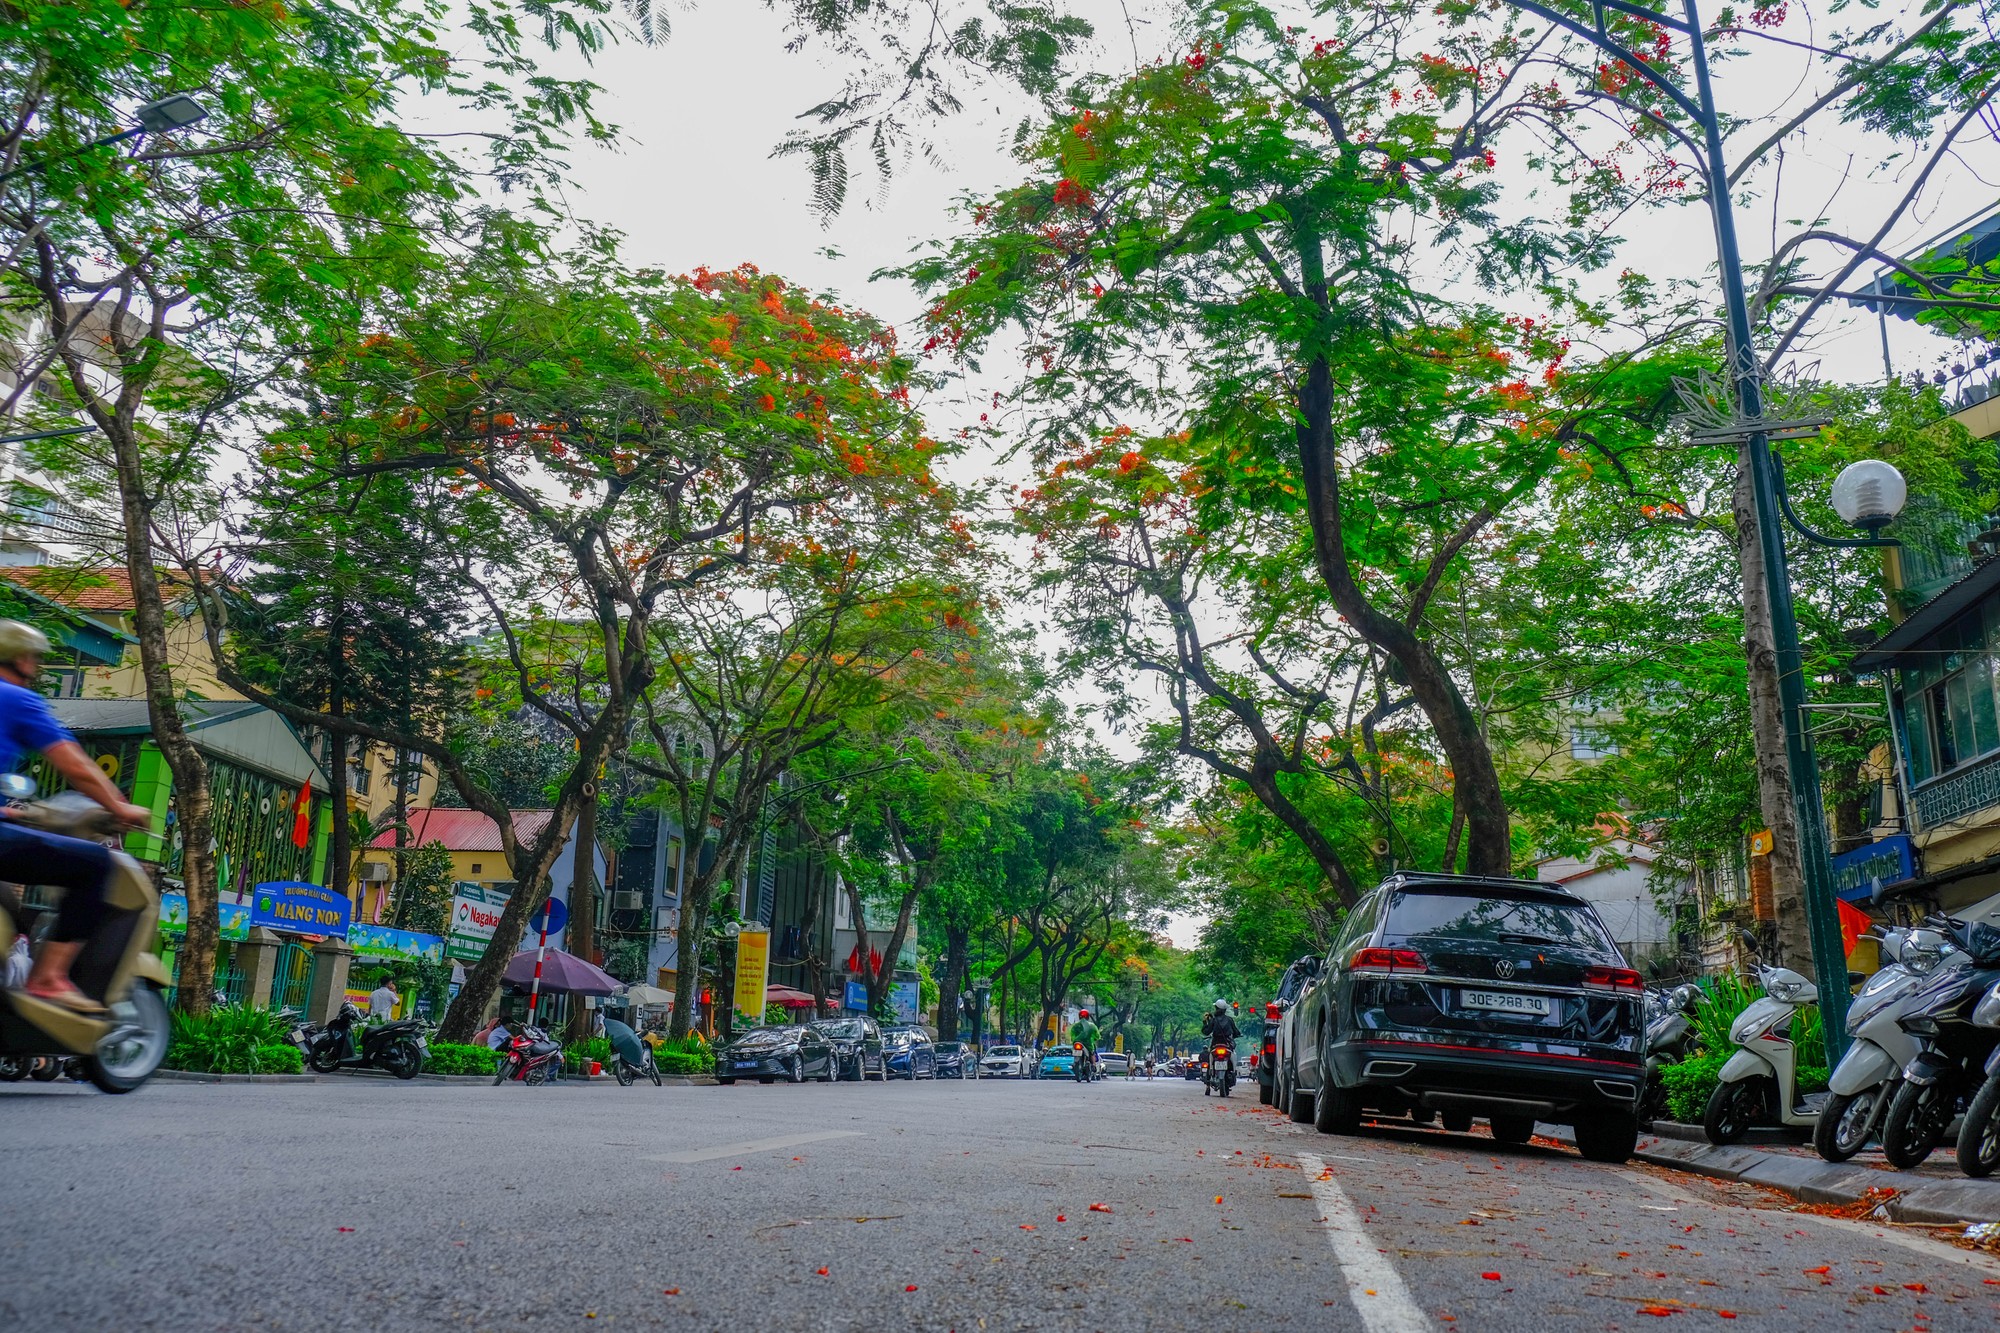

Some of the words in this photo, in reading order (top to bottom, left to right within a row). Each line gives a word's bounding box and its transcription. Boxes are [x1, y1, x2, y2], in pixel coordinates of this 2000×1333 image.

[274, 899, 314, 922] MĂNG
[315, 908, 342, 927] NON
[1469, 993, 1542, 1010] 30E-288.30
